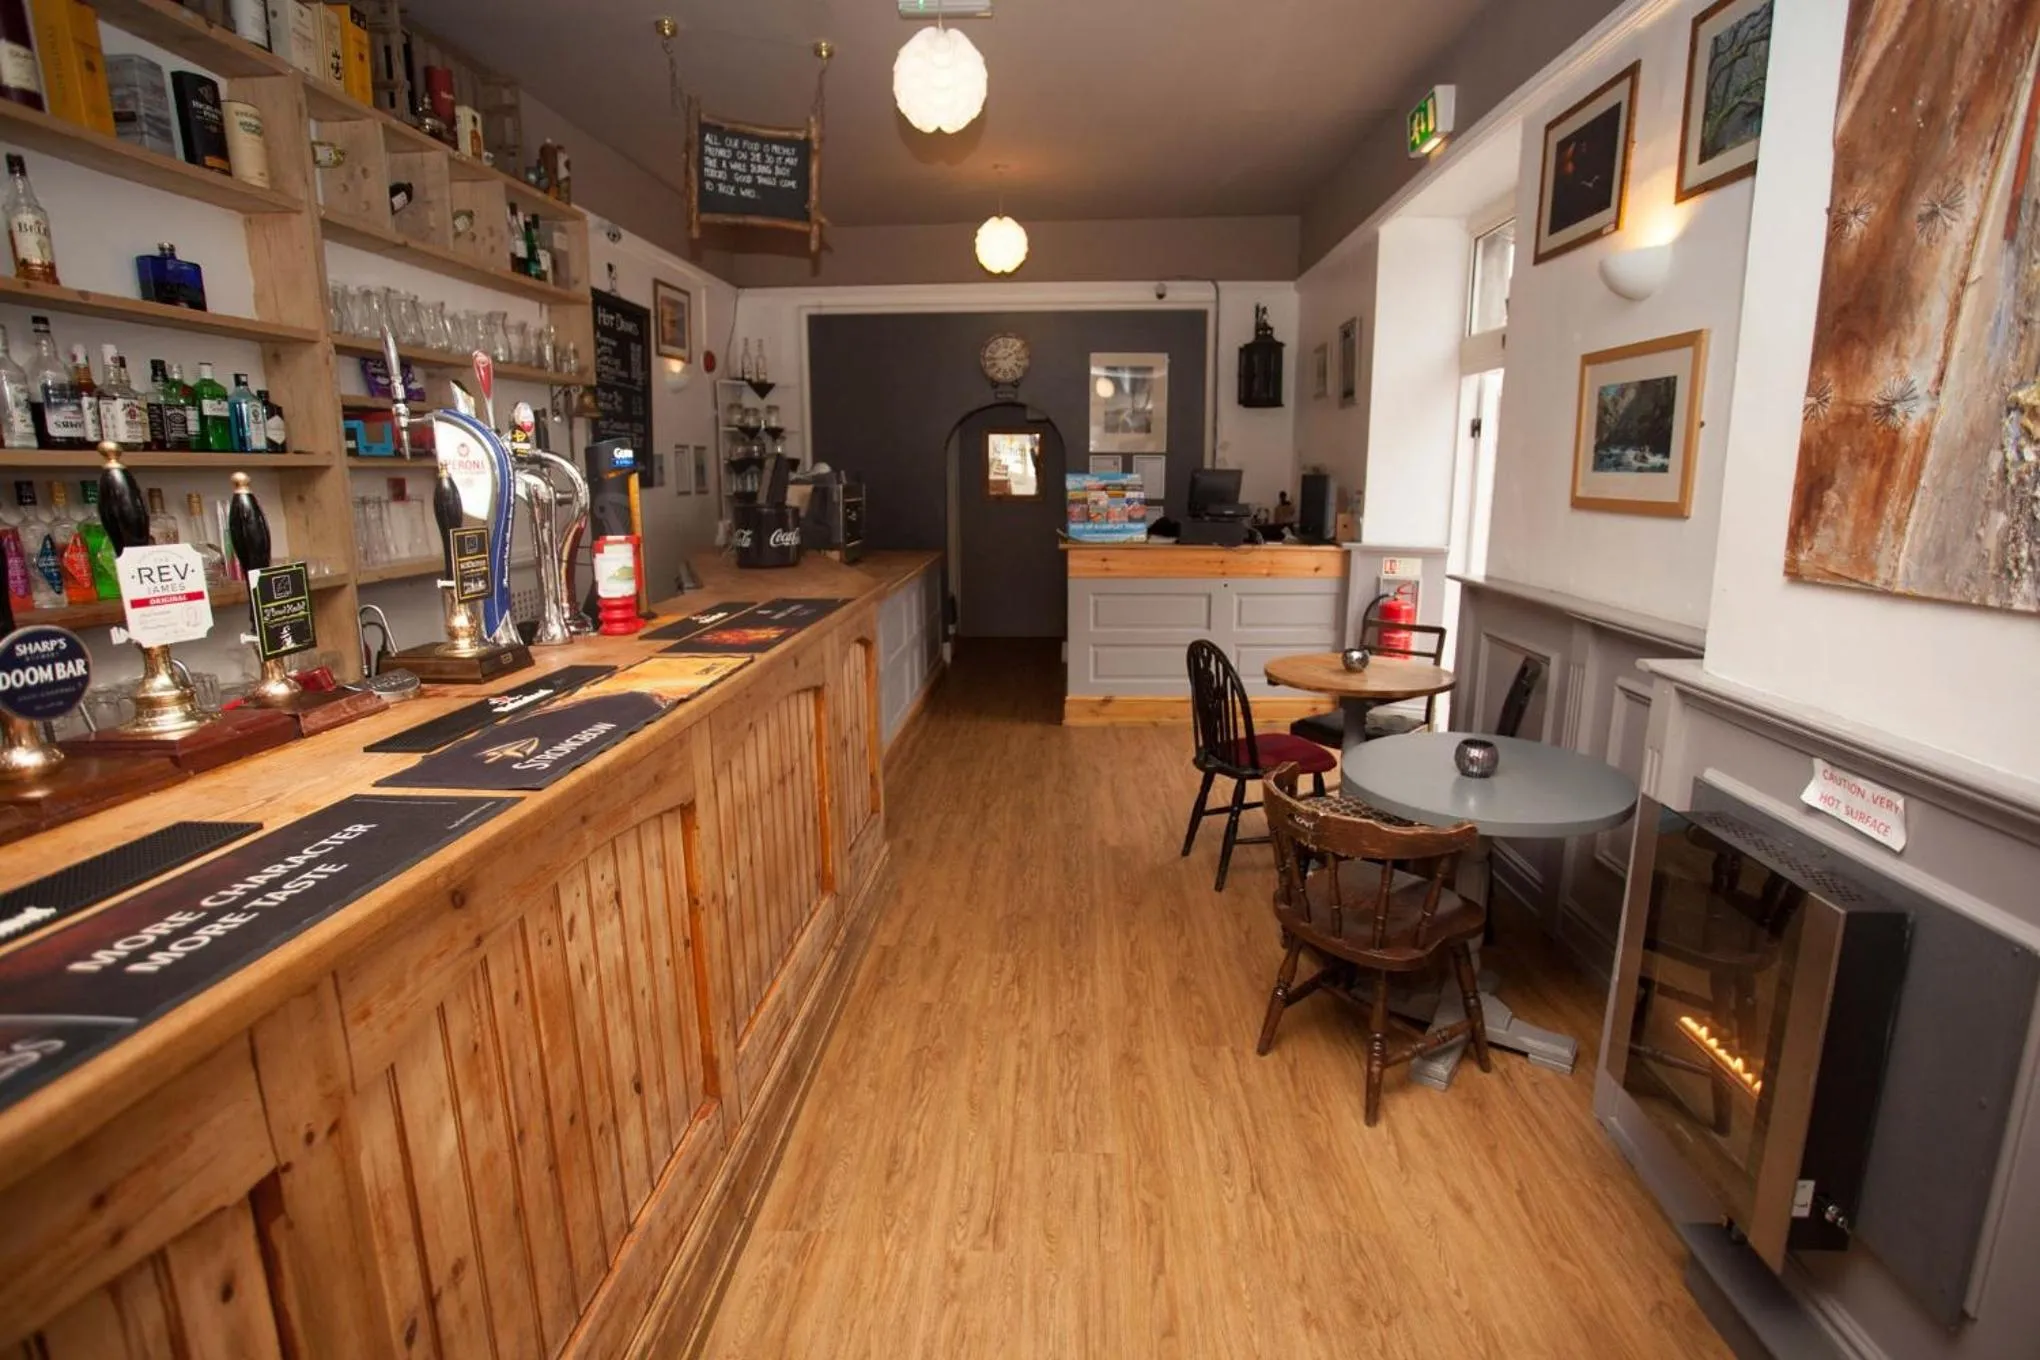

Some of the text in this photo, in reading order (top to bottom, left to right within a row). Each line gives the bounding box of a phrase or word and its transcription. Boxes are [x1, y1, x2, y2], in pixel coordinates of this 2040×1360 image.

[137, 563, 189, 584] REV
[147, 583, 186, 595] JAMES
[149, 594, 188, 605] ORIGINAL
[15, 638, 67, 657] SHARP'S
[0, 658, 87, 691] DOOM BAR
[512, 721, 617, 771] STRONGBOW
[1819, 792, 1891, 836] HOT SURFACE
[1872, 793, 1901, 815] VERY
[67, 909, 208, 972] MORE
[200, 822, 378, 909] CHARACTER
[125, 862, 349, 974] MORE TASTE
